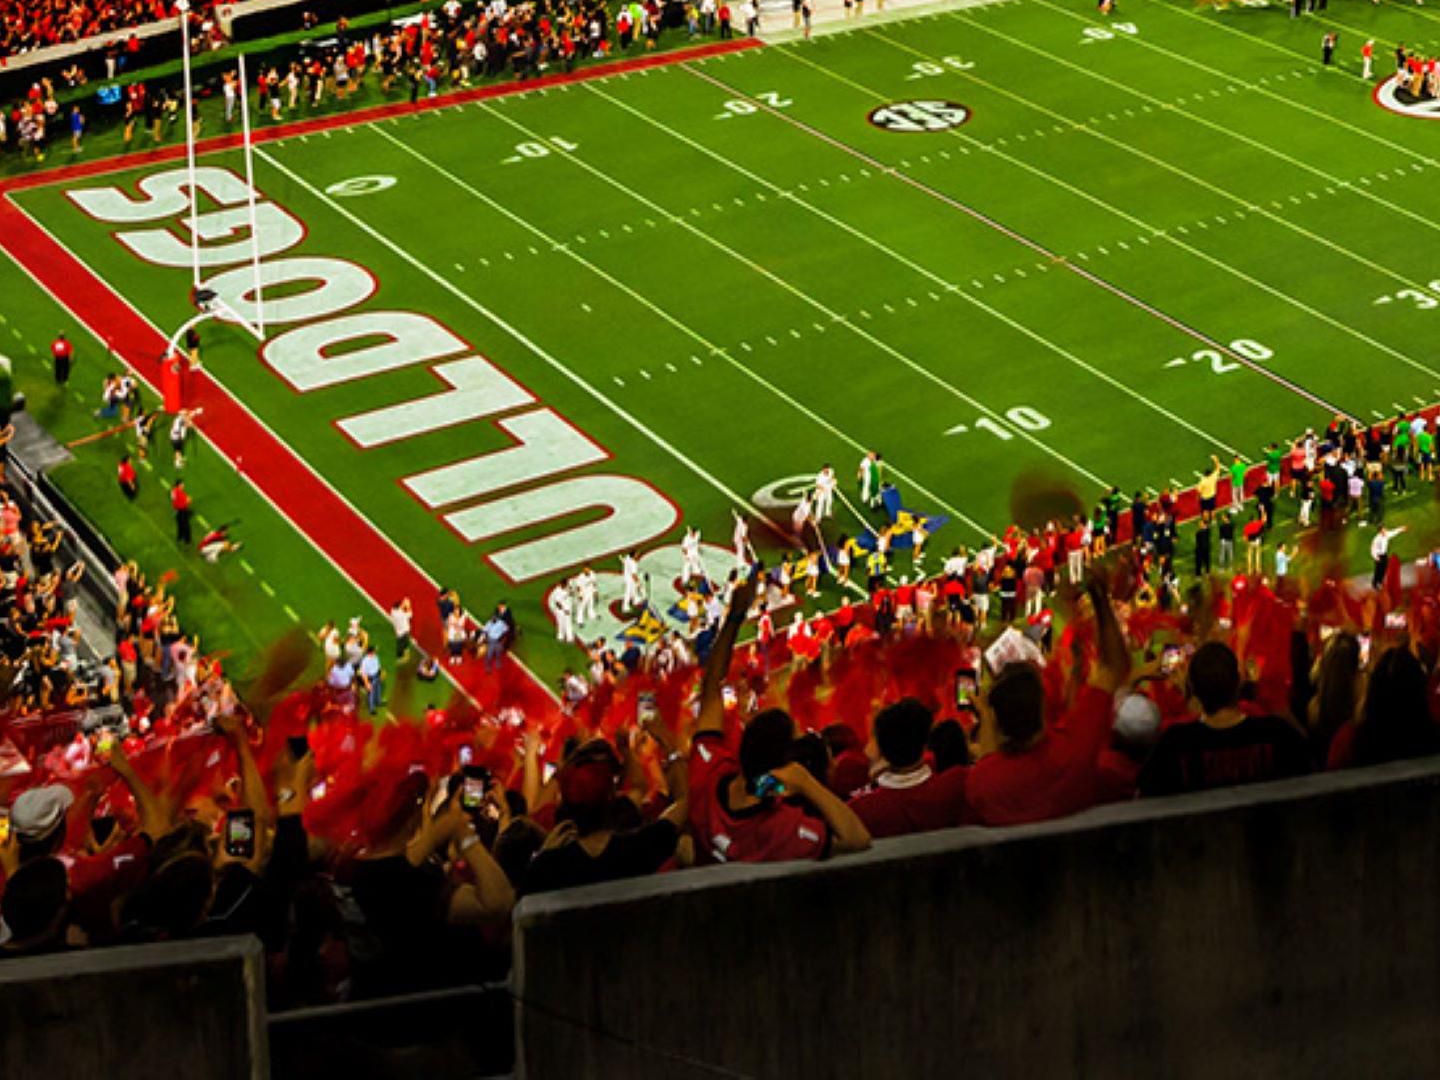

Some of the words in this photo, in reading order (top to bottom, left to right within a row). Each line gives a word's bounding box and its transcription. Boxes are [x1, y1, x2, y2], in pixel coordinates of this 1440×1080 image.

[722, 90, 794, 115] 20
[513, 135, 581, 159] 10
[1192, 337, 1274, 374] 20
[973, 405, 1053, 441] 10
